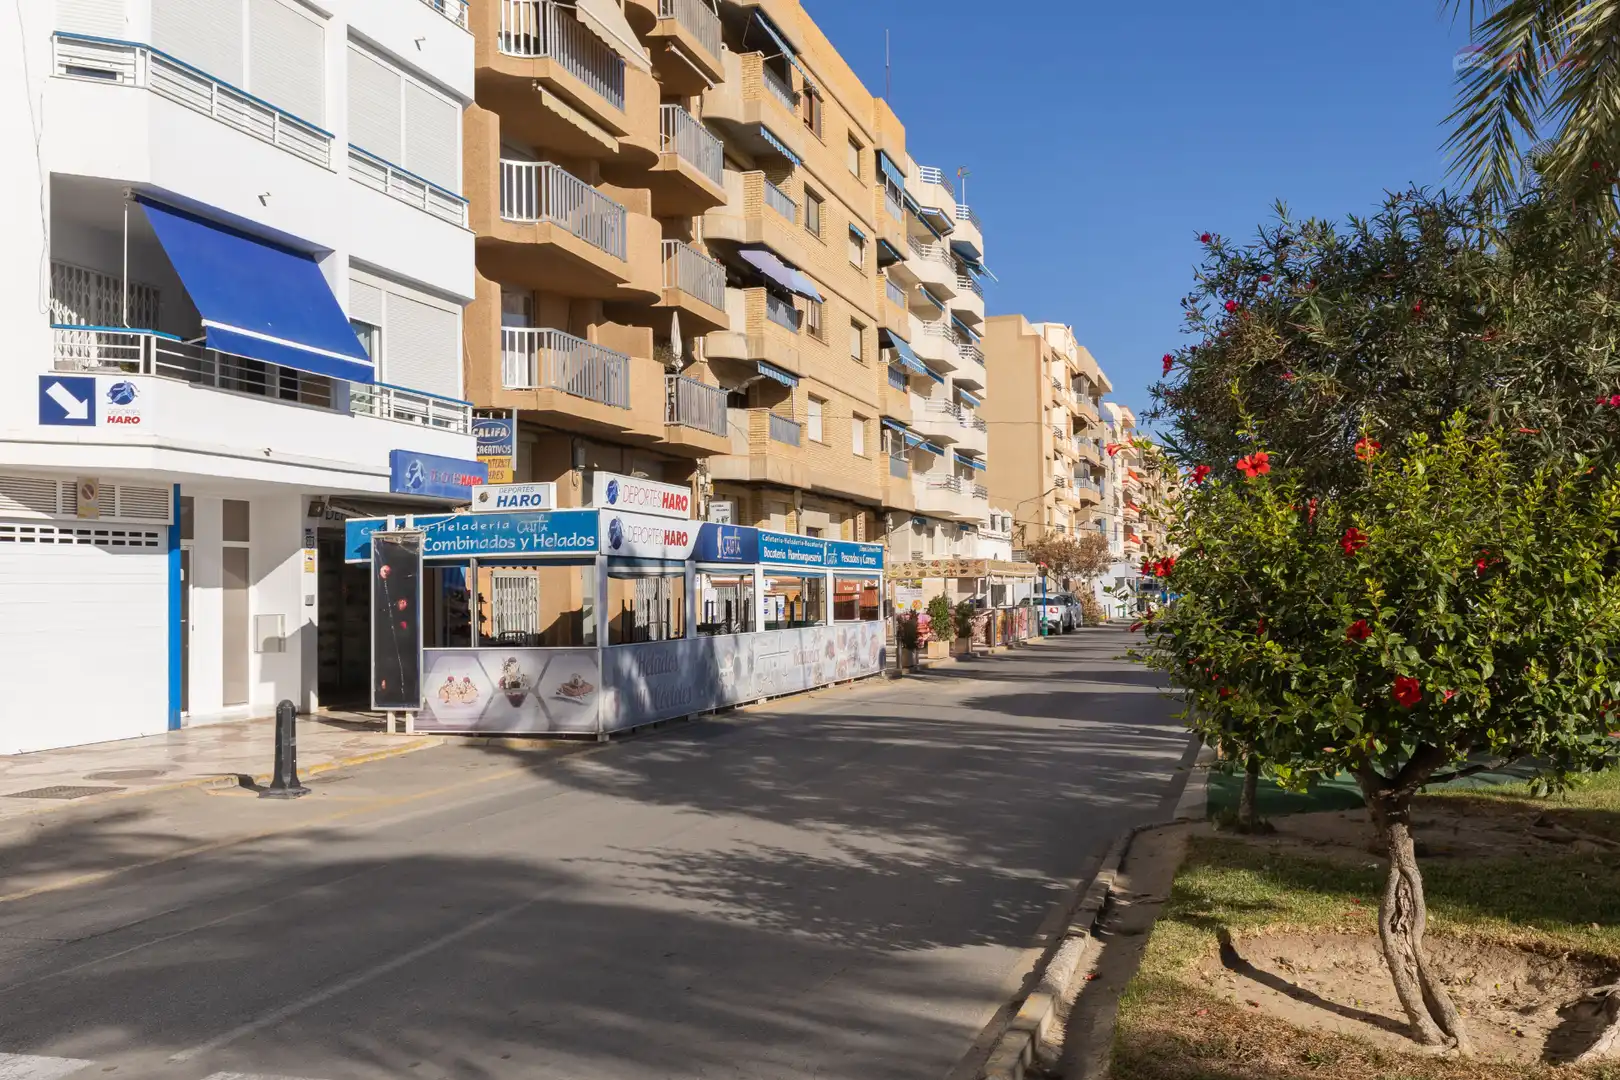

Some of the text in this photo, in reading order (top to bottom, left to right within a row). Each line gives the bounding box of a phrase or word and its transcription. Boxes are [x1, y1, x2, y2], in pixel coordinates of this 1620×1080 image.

[106, 415, 140, 424] HARO
[472, 427, 507, 439] CALIFA
[499, 486, 535, 494] DEPORTES
[496, 494, 541, 507] HARO
[622, 485, 688, 512] DEPORTES HARO
[424, 532, 595, 552] Combinados y Helados
[627, 525, 688, 547] DEPORTES HARO
